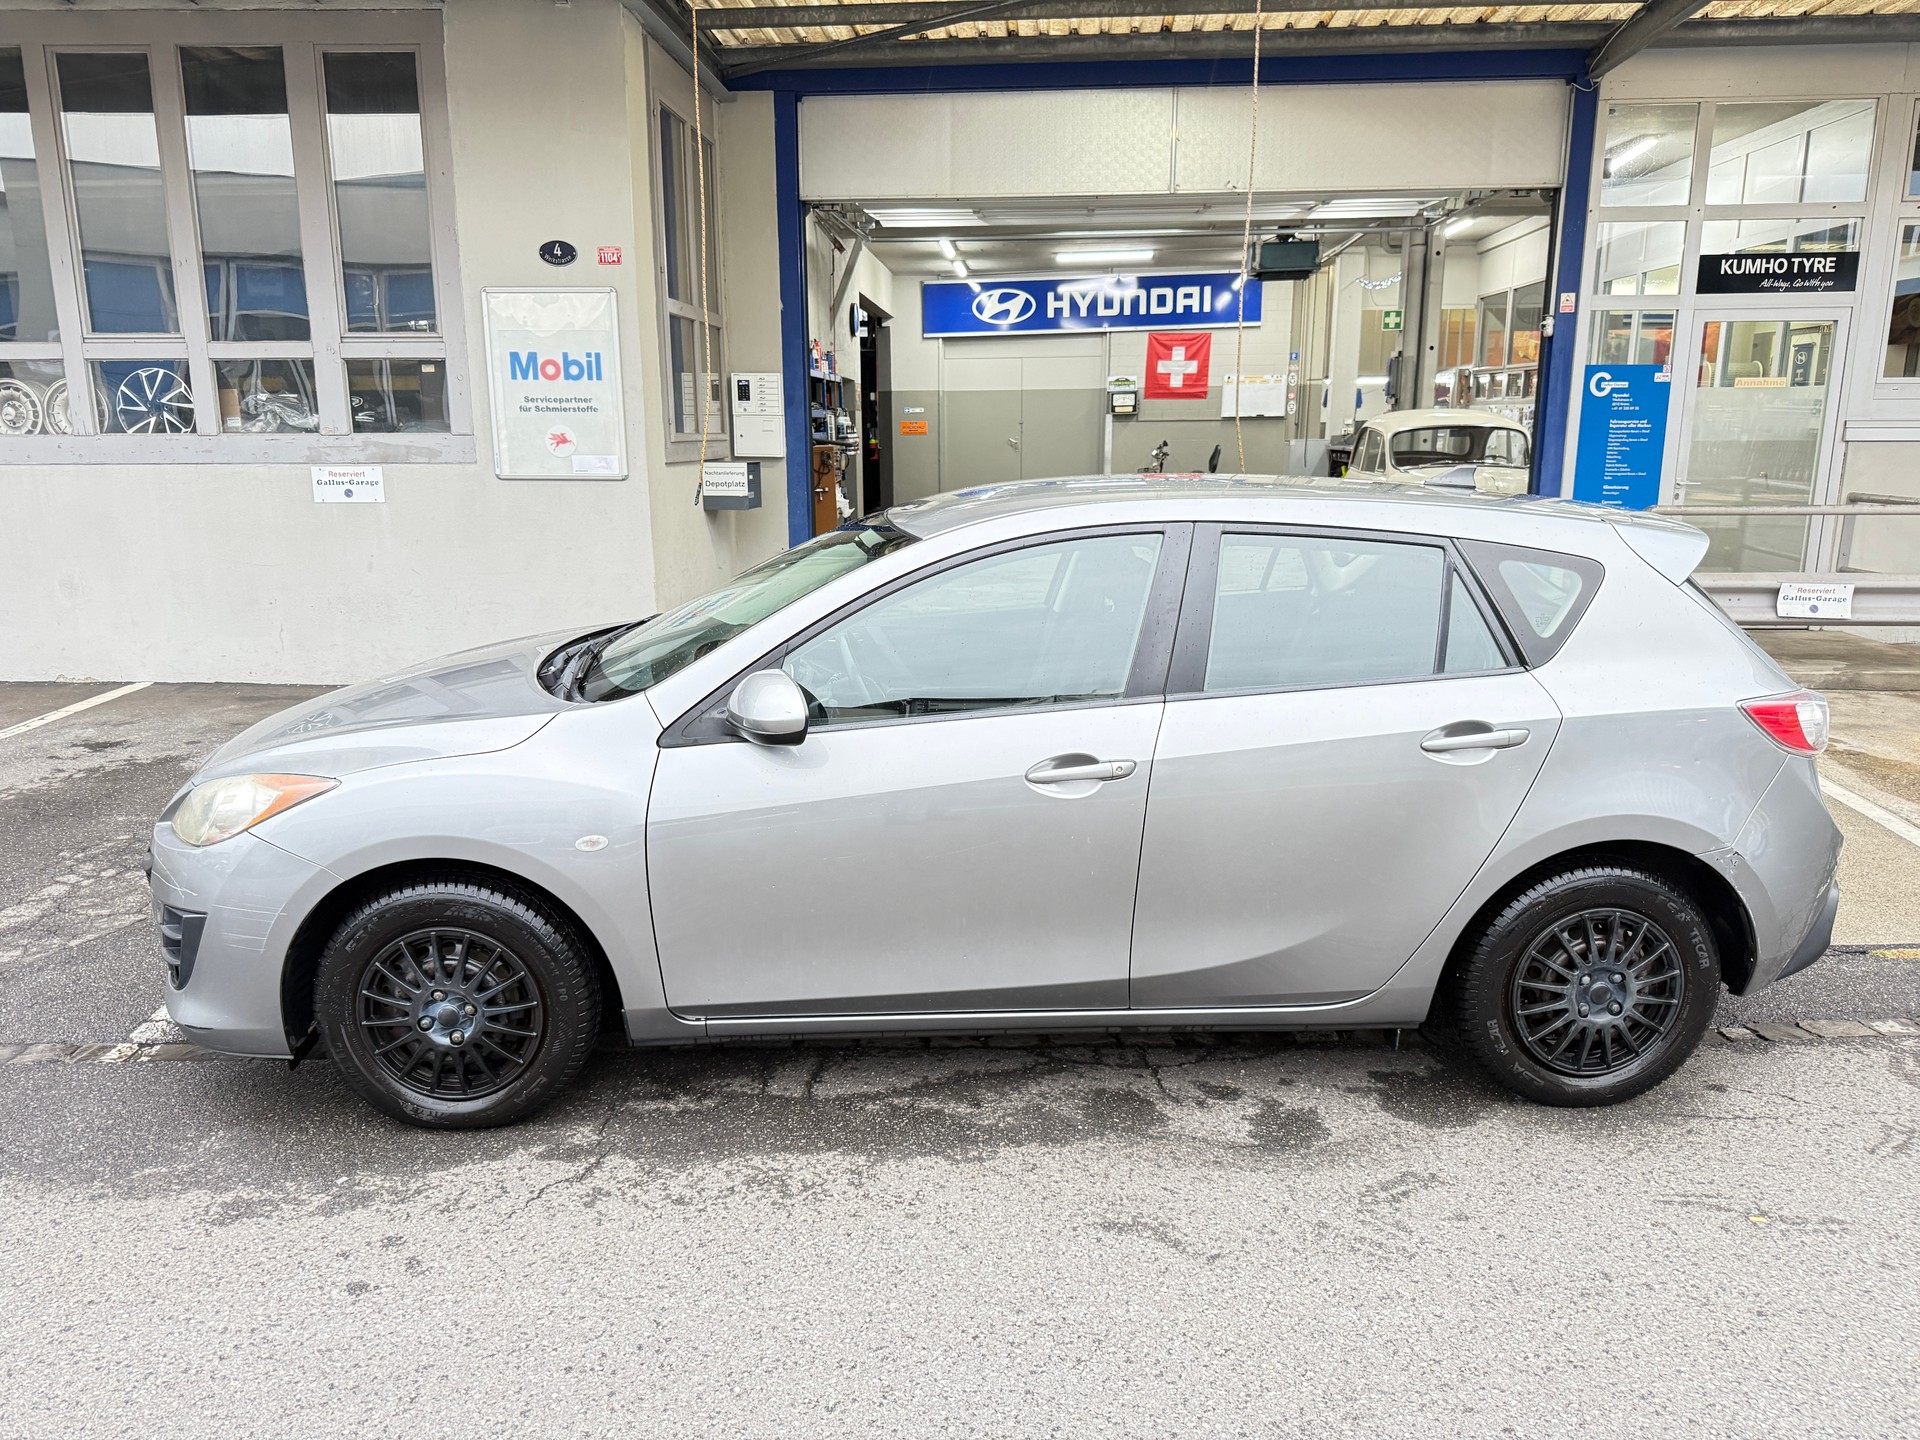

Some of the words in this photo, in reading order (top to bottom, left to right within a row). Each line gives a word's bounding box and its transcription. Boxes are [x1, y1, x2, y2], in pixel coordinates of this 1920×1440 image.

[553, 243, 562, 257] 4
[601, 252, 618, 263] 1104
[1720, 258, 1788, 275] KUMHO
[1791, 257, 1837, 273] TYRE
[1047, 286, 1211, 318] HYUNDAI
[509, 351, 603, 382] Mobil
[1735, 379, 1786, 387] Annahme
[524, 395, 593, 405] Servicepartner
[519, 405, 532, 413] für
[534, 405, 599, 413] Schmierstoffe
[328, 470, 366, 478] Reserviert
[316, 479, 379, 487] Gallus-Garage
[705, 480, 746, 489] Depotplatz
[1796, 587, 1836, 595] Reserviert
[1782, 594, 1848, 603] Gallus-Garage
[1689, 926, 1711, 970] TECAR
